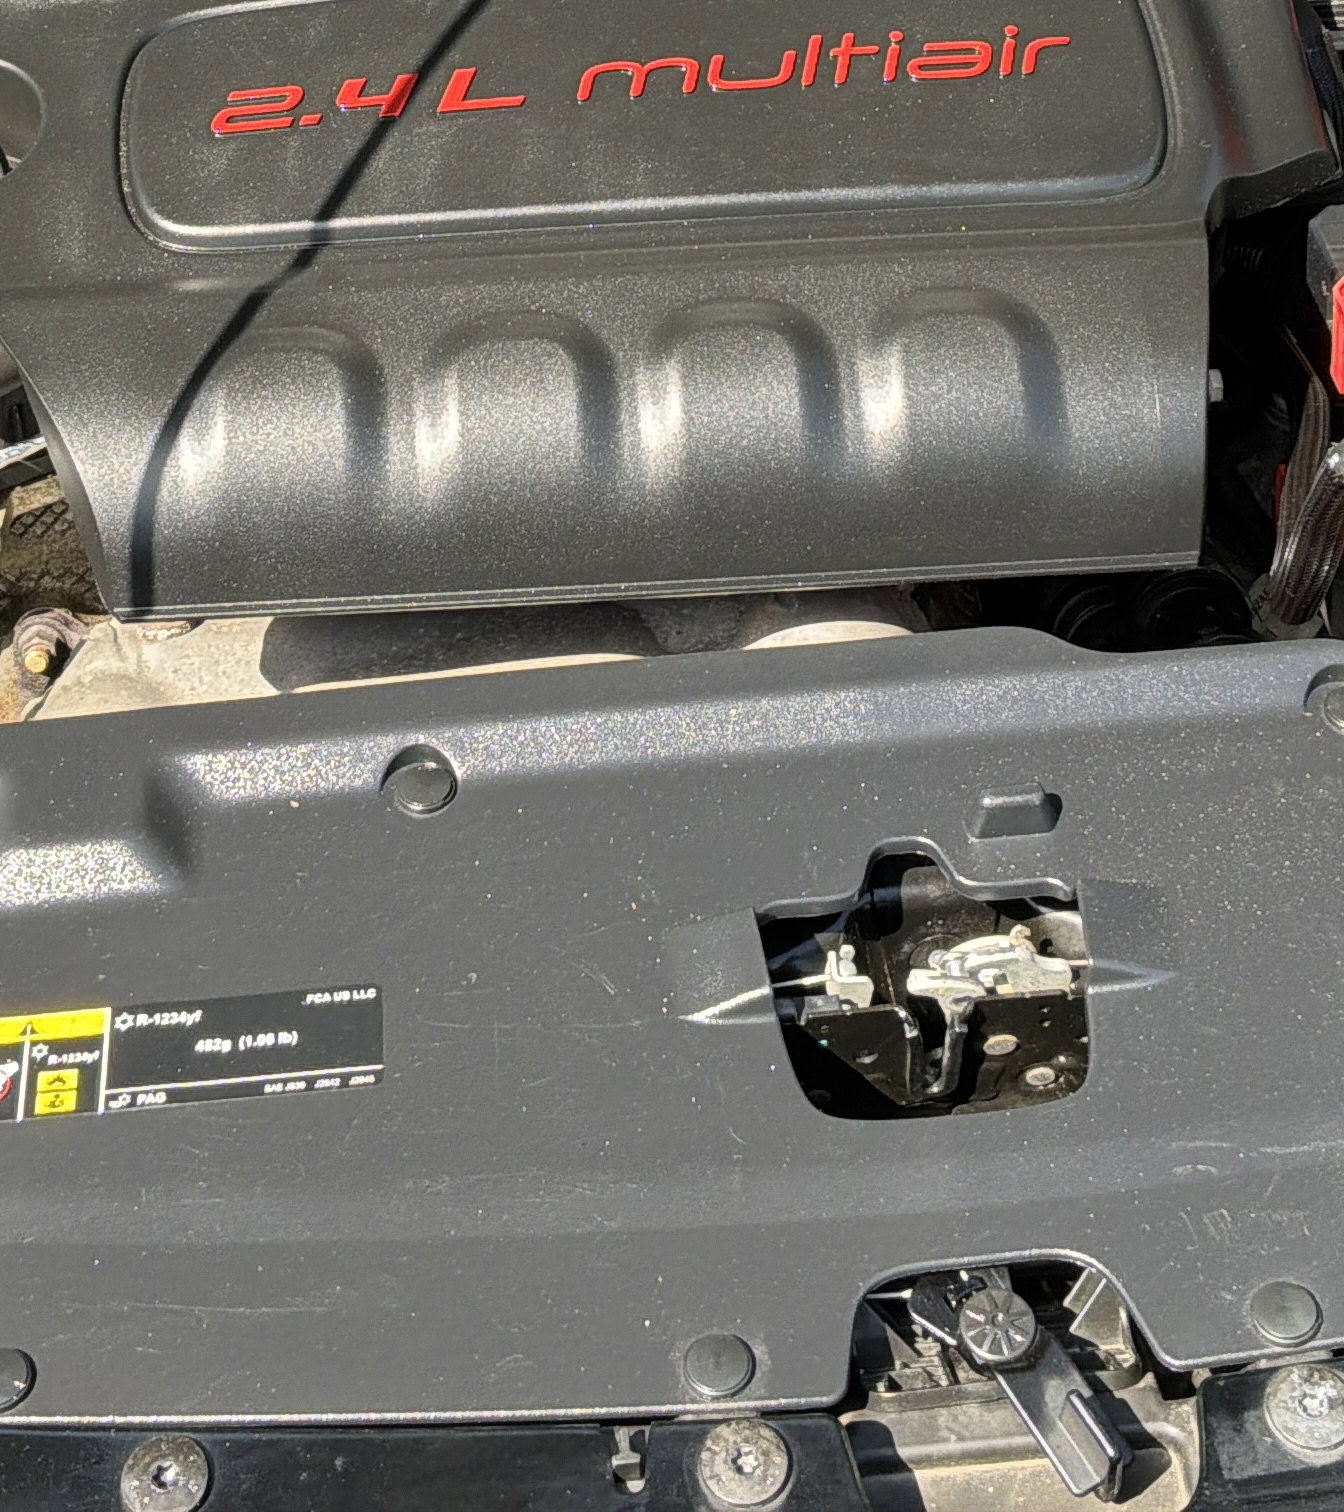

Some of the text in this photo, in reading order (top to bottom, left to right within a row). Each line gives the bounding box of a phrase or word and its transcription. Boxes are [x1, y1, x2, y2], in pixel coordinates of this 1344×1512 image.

[211, 24, 1072, 138] 2.4L multiair
[305, 992, 332, 1006] FCA
[352, 987, 377, 1001] LLC
[135, 1009, 204, 1028] R-1234yf
[277, 1030, 299, 1047] lb)
